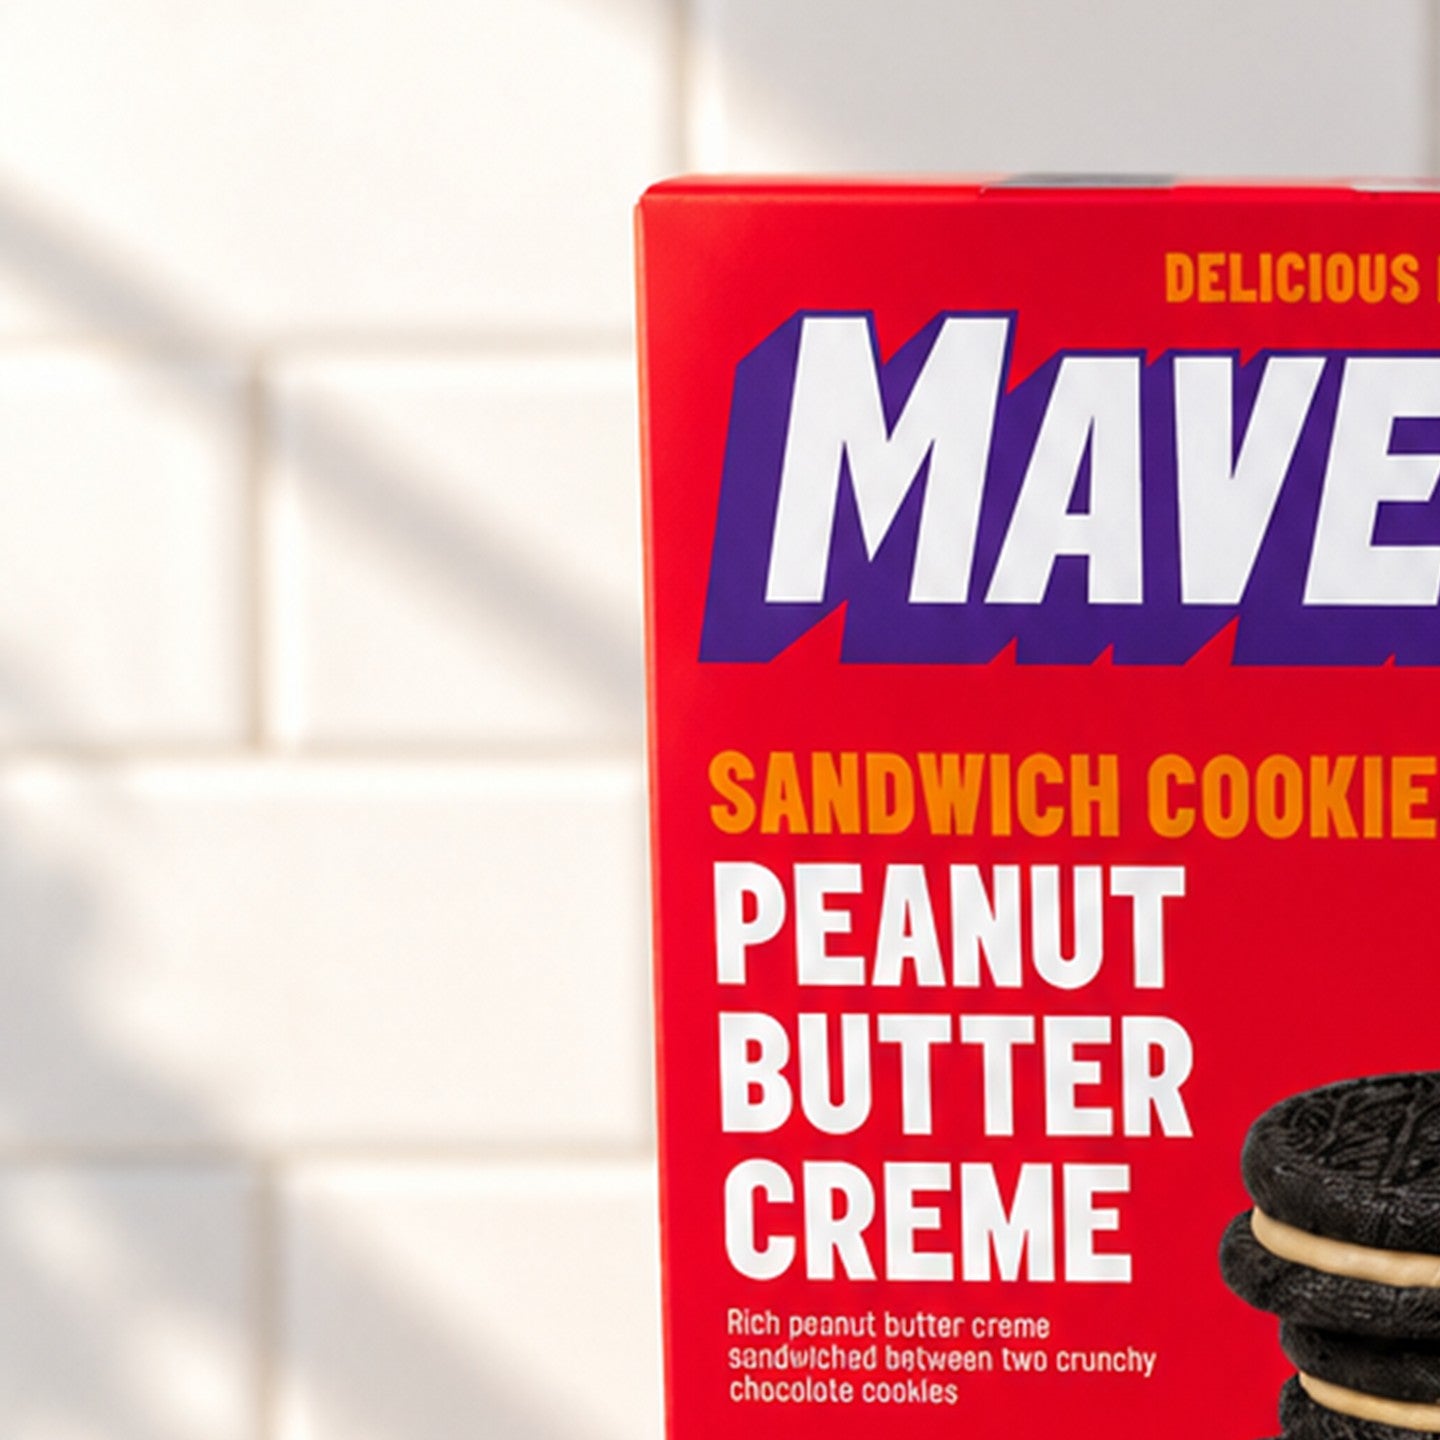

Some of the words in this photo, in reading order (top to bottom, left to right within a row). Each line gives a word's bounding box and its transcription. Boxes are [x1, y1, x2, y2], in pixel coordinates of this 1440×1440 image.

[1165, 252, 1420, 304] DELICIOUS
[708, 750, 1120, 837] SANDWICH
[713, 861, 1186, 990] PEANUT
[718, 1011, 1193, 1138] BUTTER
[724, 1158, 1132, 1283] CREME
[727, 1308, 780, 1335] Rich
[789, 1309, 876, 1340] peanut
[884, 1312, 964, 1338] butter
[972, 1317, 1051, 1339] creme
[1002, 1348, 1047, 1372] two
[1056, 1347, 1156, 1378] crunchy
